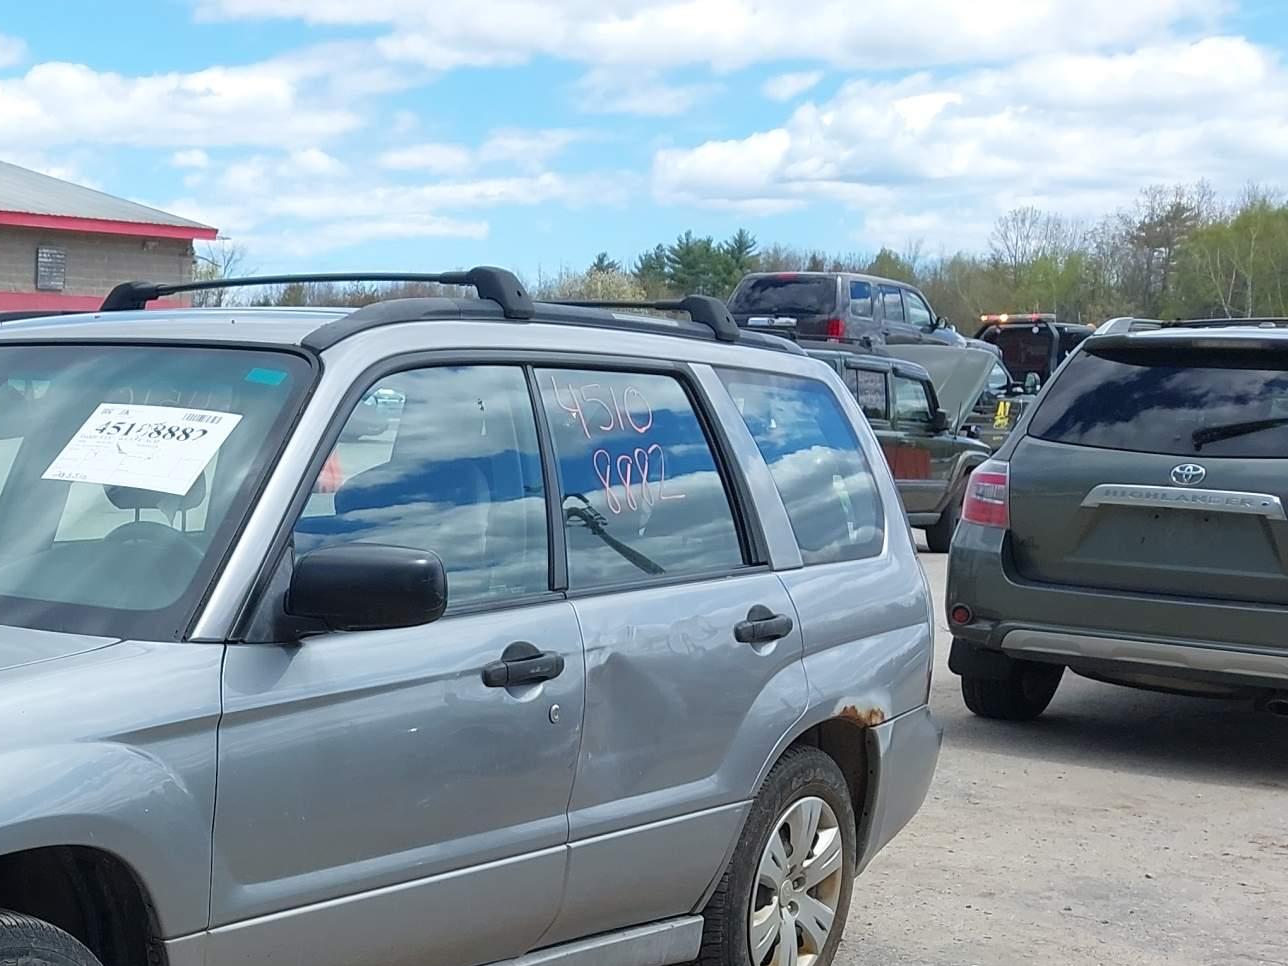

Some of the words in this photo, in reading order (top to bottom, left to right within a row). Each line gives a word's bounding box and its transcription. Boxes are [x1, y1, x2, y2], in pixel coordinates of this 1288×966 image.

[550, 375, 653, 440] 4510
[593, 443, 686, 514] 8882
[1103, 488, 1256, 507] HIGHLANDER
